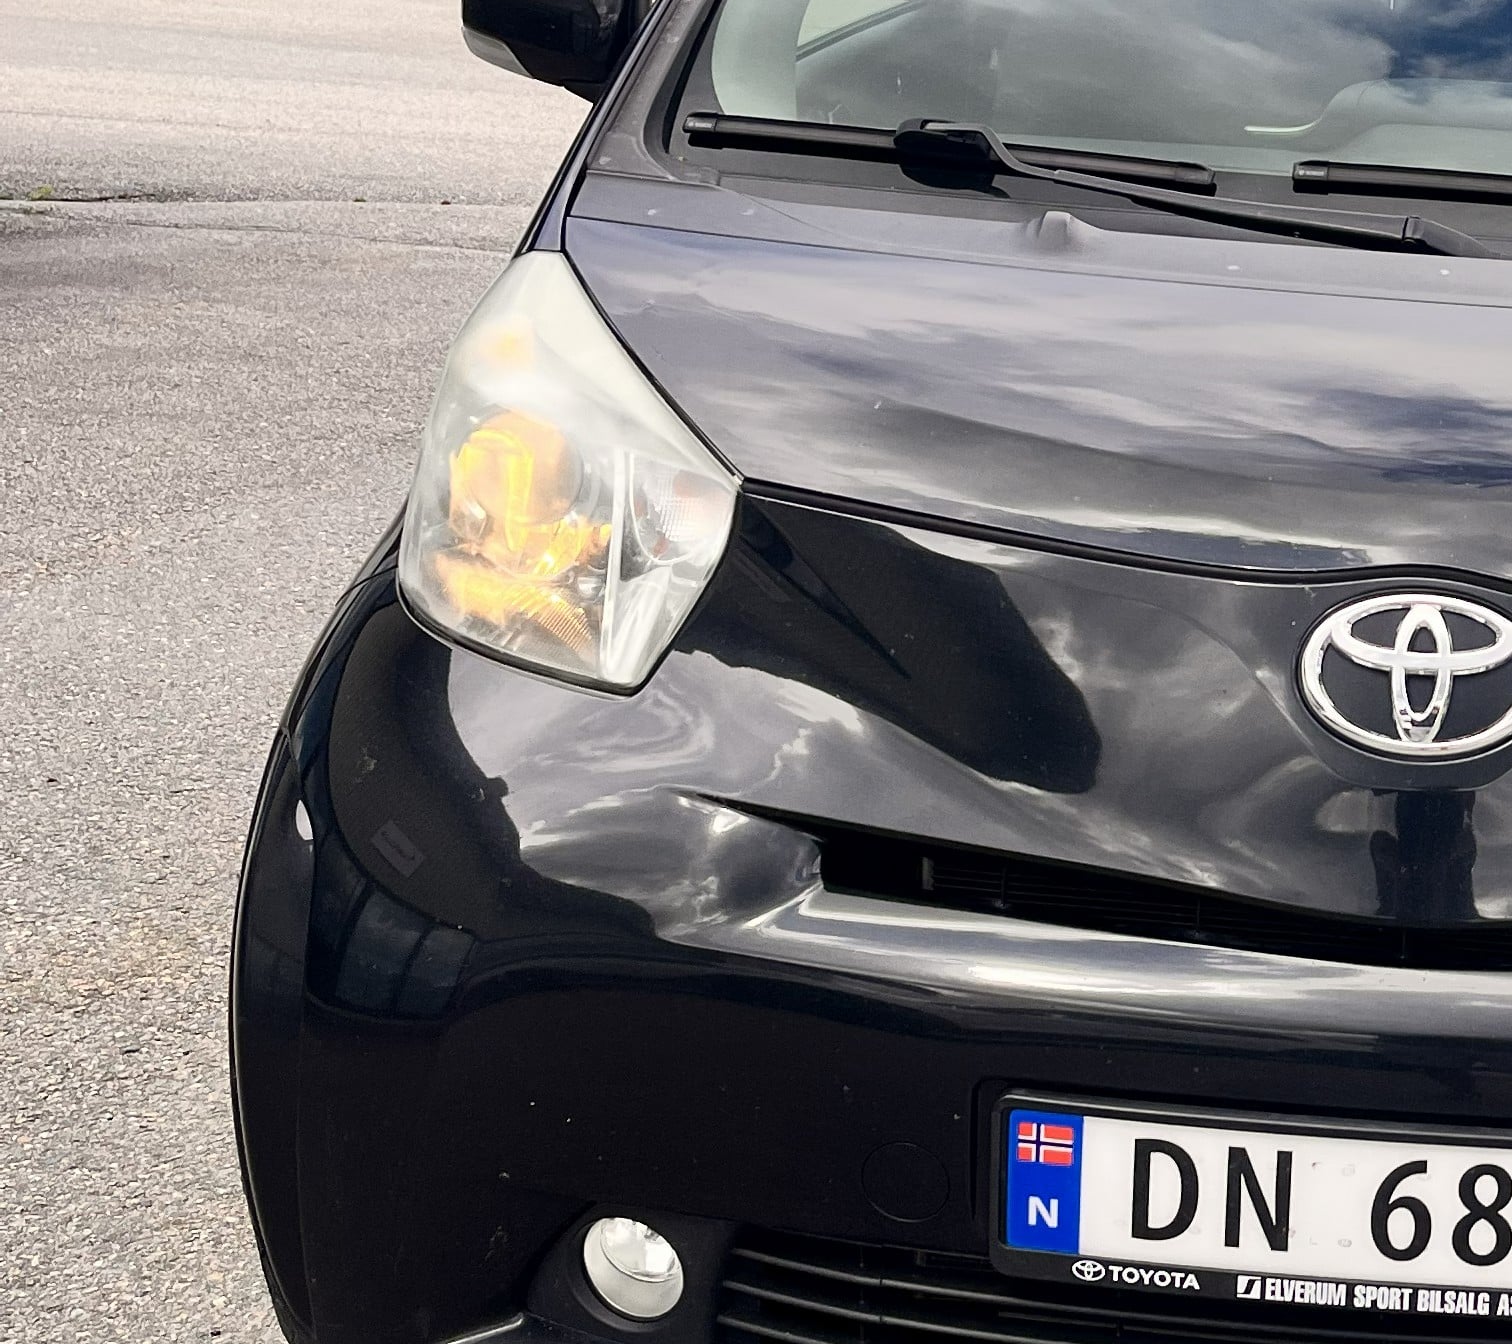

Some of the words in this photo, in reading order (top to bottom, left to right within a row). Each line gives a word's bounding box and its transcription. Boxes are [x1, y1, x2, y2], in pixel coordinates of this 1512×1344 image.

[1027, 1195, 1059, 1229] N
[1131, 1138, 1293, 1252] DN
[1108, 1264, 1201, 1291] TOYOTA
[1264, 1277, 1347, 1307] ELVERUM
[1353, 1284, 1413, 1311] SPORT
[1416, 1287, 1490, 1316] BILSALG
